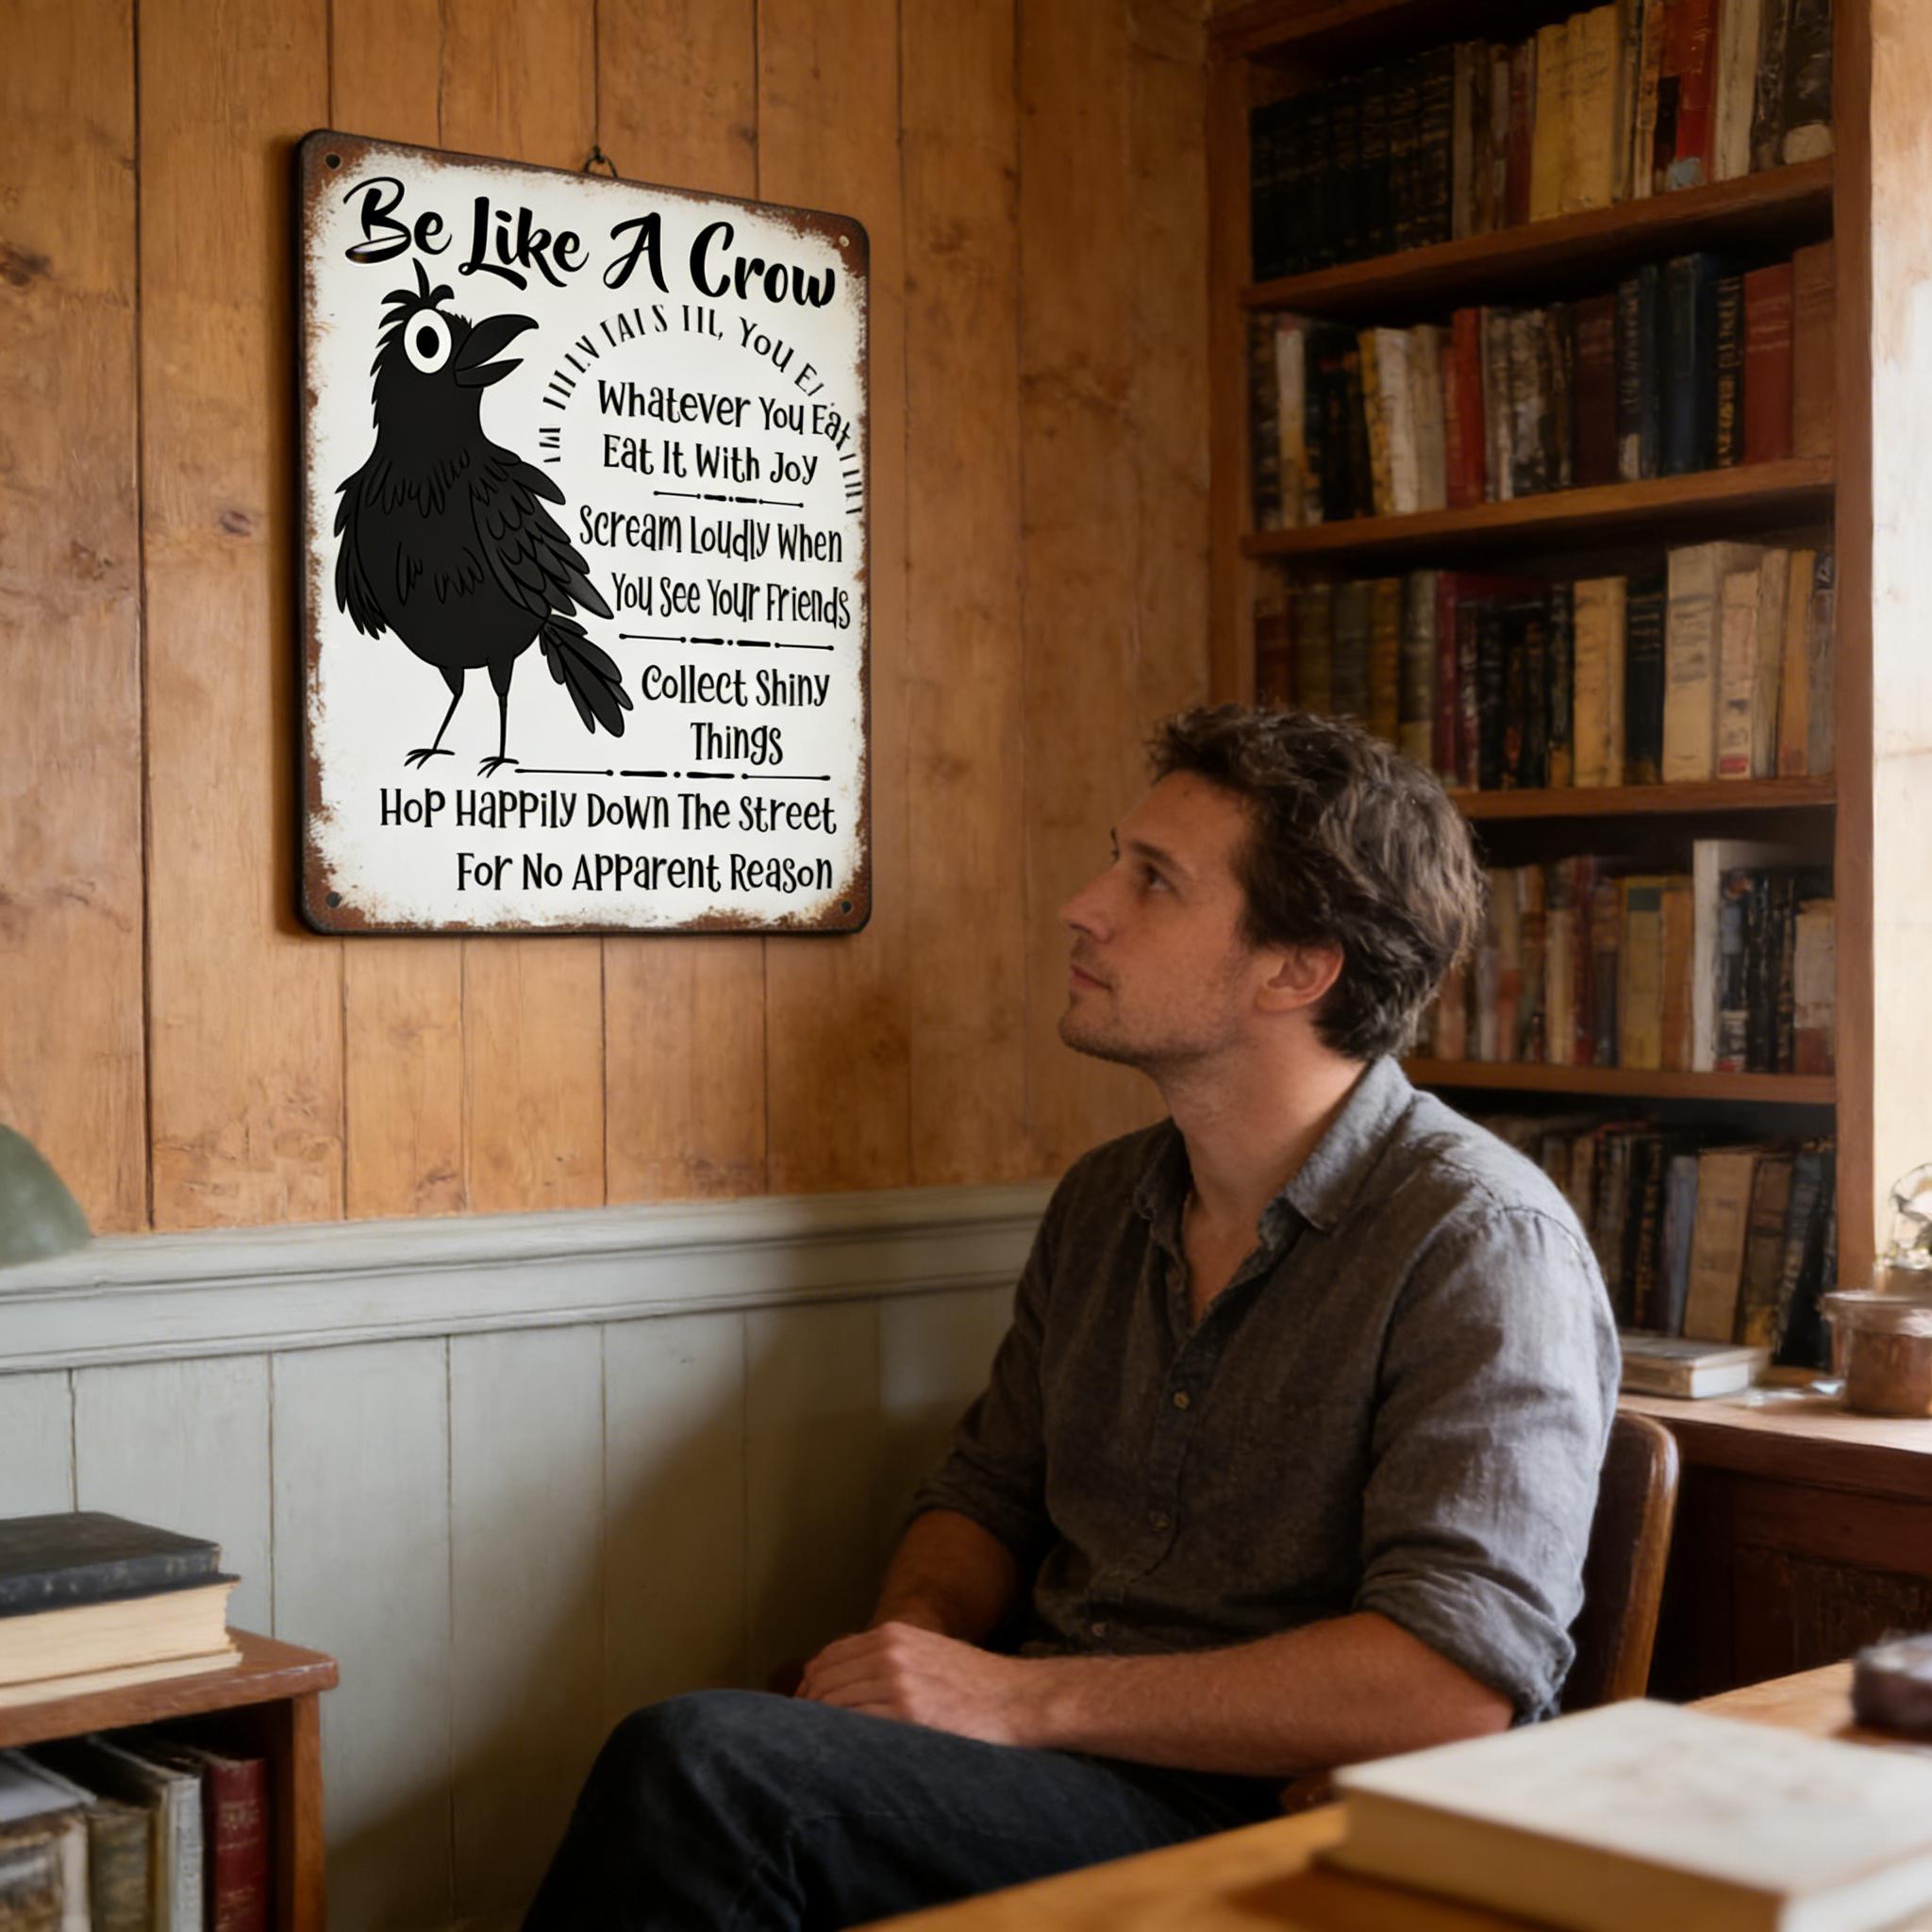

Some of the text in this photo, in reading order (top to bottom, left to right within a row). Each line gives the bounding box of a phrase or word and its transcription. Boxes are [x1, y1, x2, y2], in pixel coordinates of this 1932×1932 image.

[343, 176, 836, 308] Be Like A Crow
[740, 316, 794, 373] You
[597, 379, 851, 451] Whatever You Eat
[603, 433, 655, 475] Eat
[663, 440, 687, 478] It
[695, 443, 760, 483] With
[769, 451, 818, 486] Joy
[579, 505, 842, 563] Scream Loudly When
[610, 572, 851, 630] You See Your Friends
[641, 664, 830, 707] Collect Shiny
[690, 722, 784, 766] Things
[379, 788, 838, 835] Hop Happily Down The Street
[457, 852, 834, 894] For No Apparent Reason
